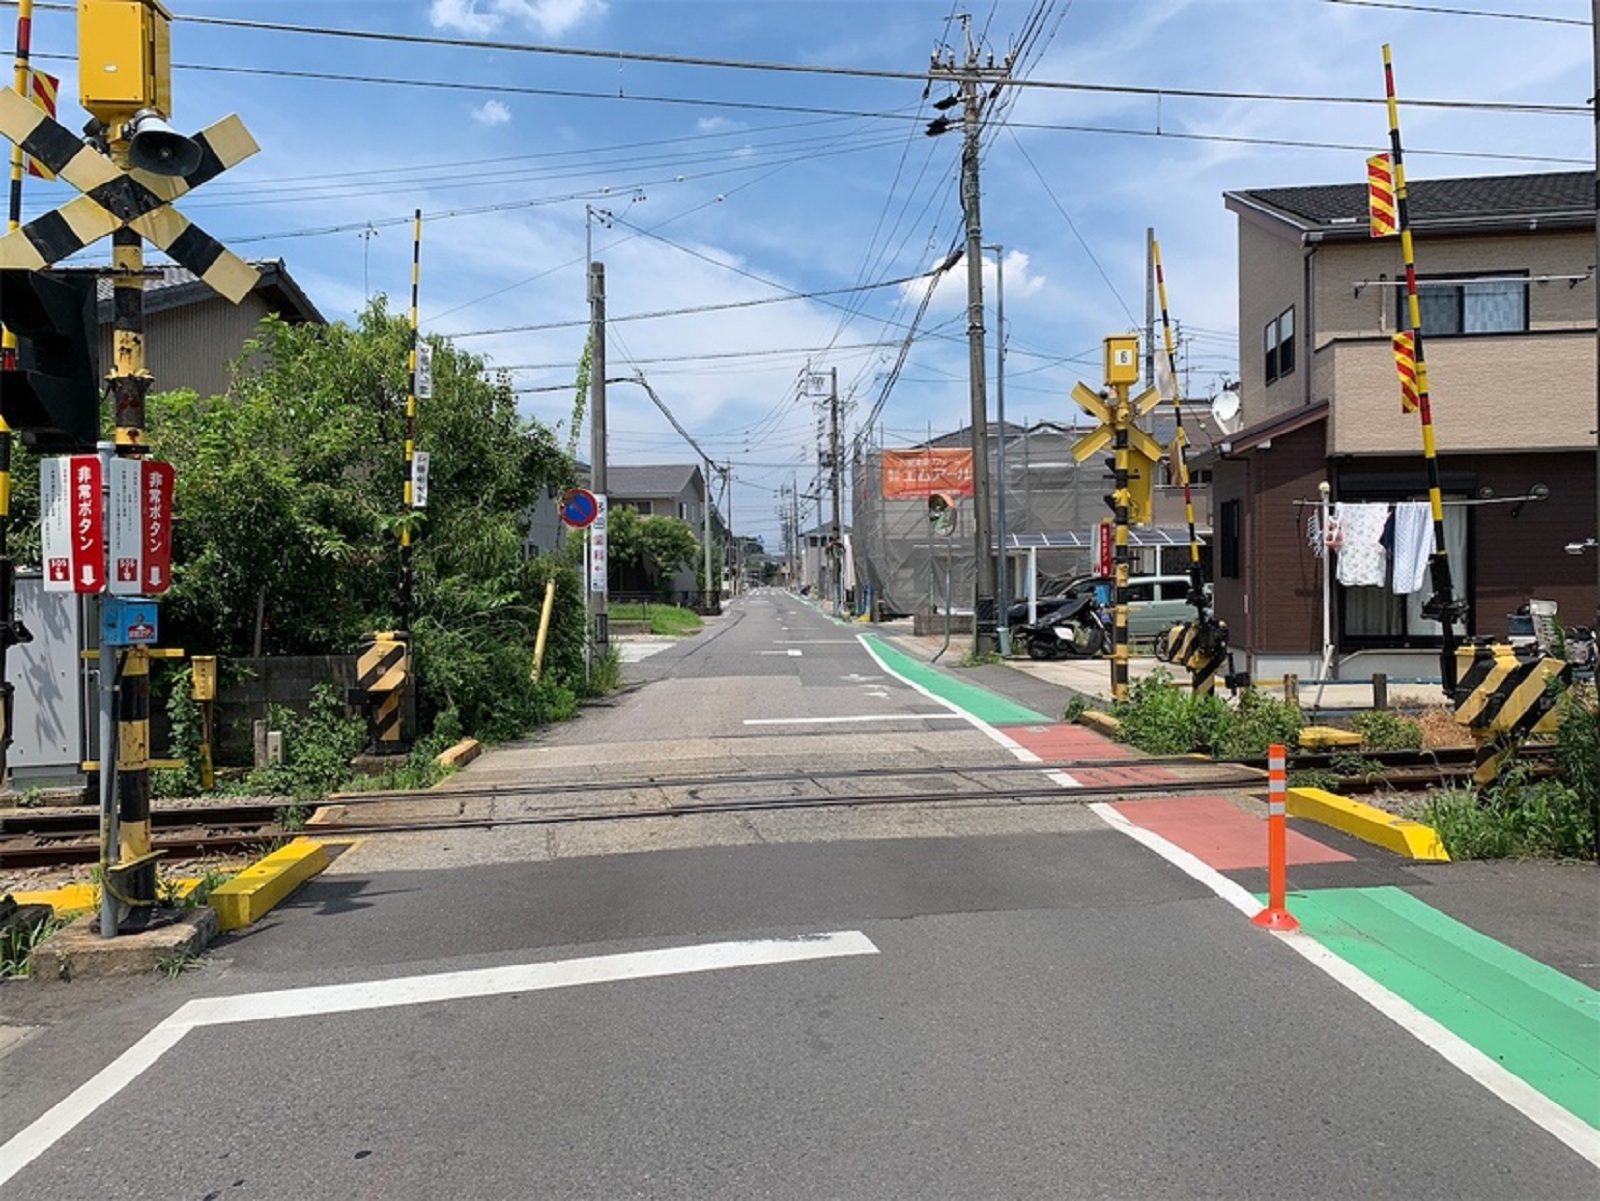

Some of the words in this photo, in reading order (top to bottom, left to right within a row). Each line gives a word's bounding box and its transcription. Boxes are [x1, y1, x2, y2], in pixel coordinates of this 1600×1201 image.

[1120, 350, 1128, 364] 6
[903, 467, 973, 482] エムアール
[77, 465, 94, 551] 非常ボタン
[149, 471, 163, 553] 非常ボタン
